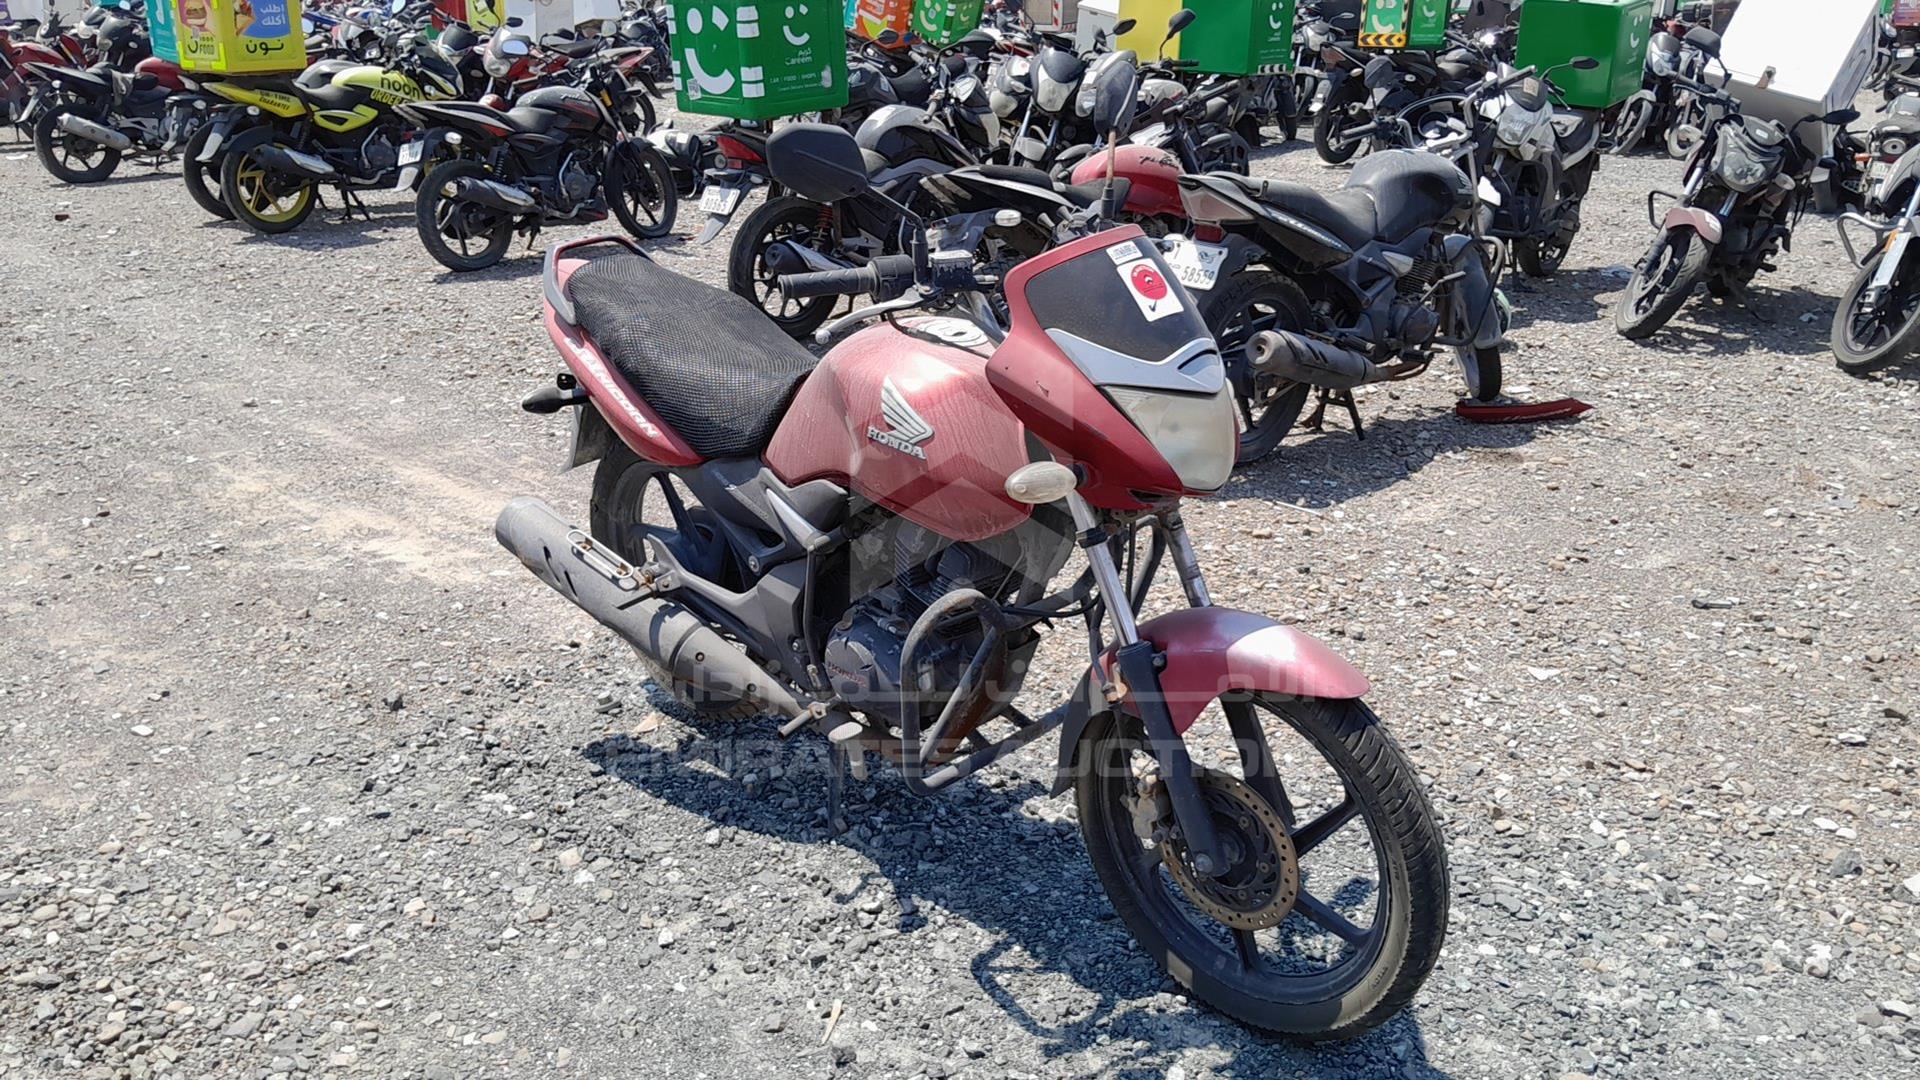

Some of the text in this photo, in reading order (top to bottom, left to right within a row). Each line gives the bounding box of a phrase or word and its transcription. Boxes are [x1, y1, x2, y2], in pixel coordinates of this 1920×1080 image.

[260, 4, 285, 13] اطلب
[261, 15, 286, 27] أكلك
[245, 39, 285, 56] نون
[784, 56, 813, 66] Careem
[380, 76, 420, 100] noon
[1181, 265, 1216, 285] 58559
[866, 424, 928, 461] HONDA
